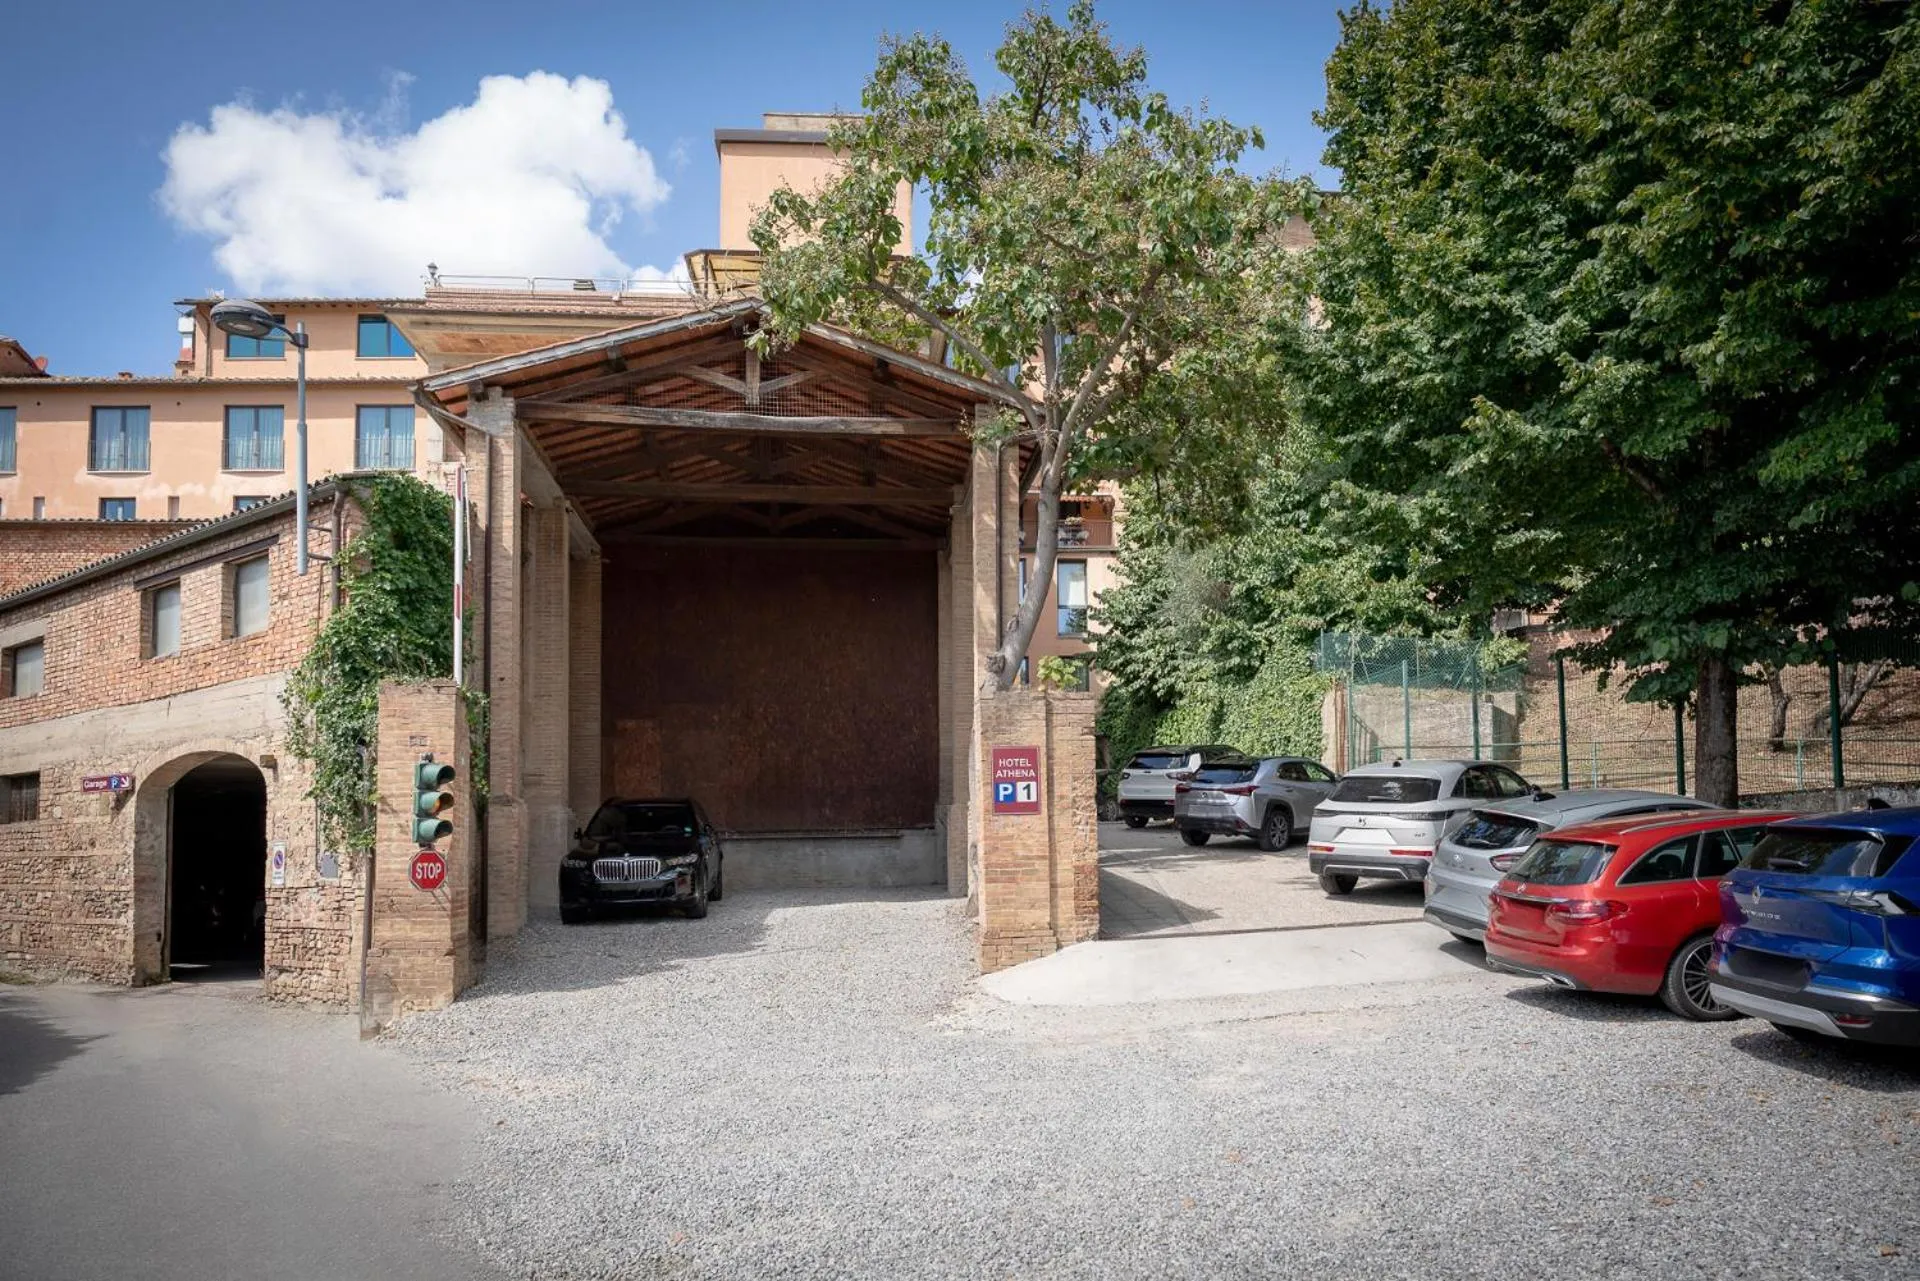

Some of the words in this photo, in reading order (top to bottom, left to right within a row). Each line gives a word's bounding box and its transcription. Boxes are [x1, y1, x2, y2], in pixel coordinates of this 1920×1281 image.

[999, 758, 1032, 767] HOTEL
[995, 769, 1036, 778] ATHENA
[84, 777, 107, 789] Garage
[999, 783, 1013, 802] P
[1022, 783, 1031, 800] 1
[415, 862, 442, 880] STOP
